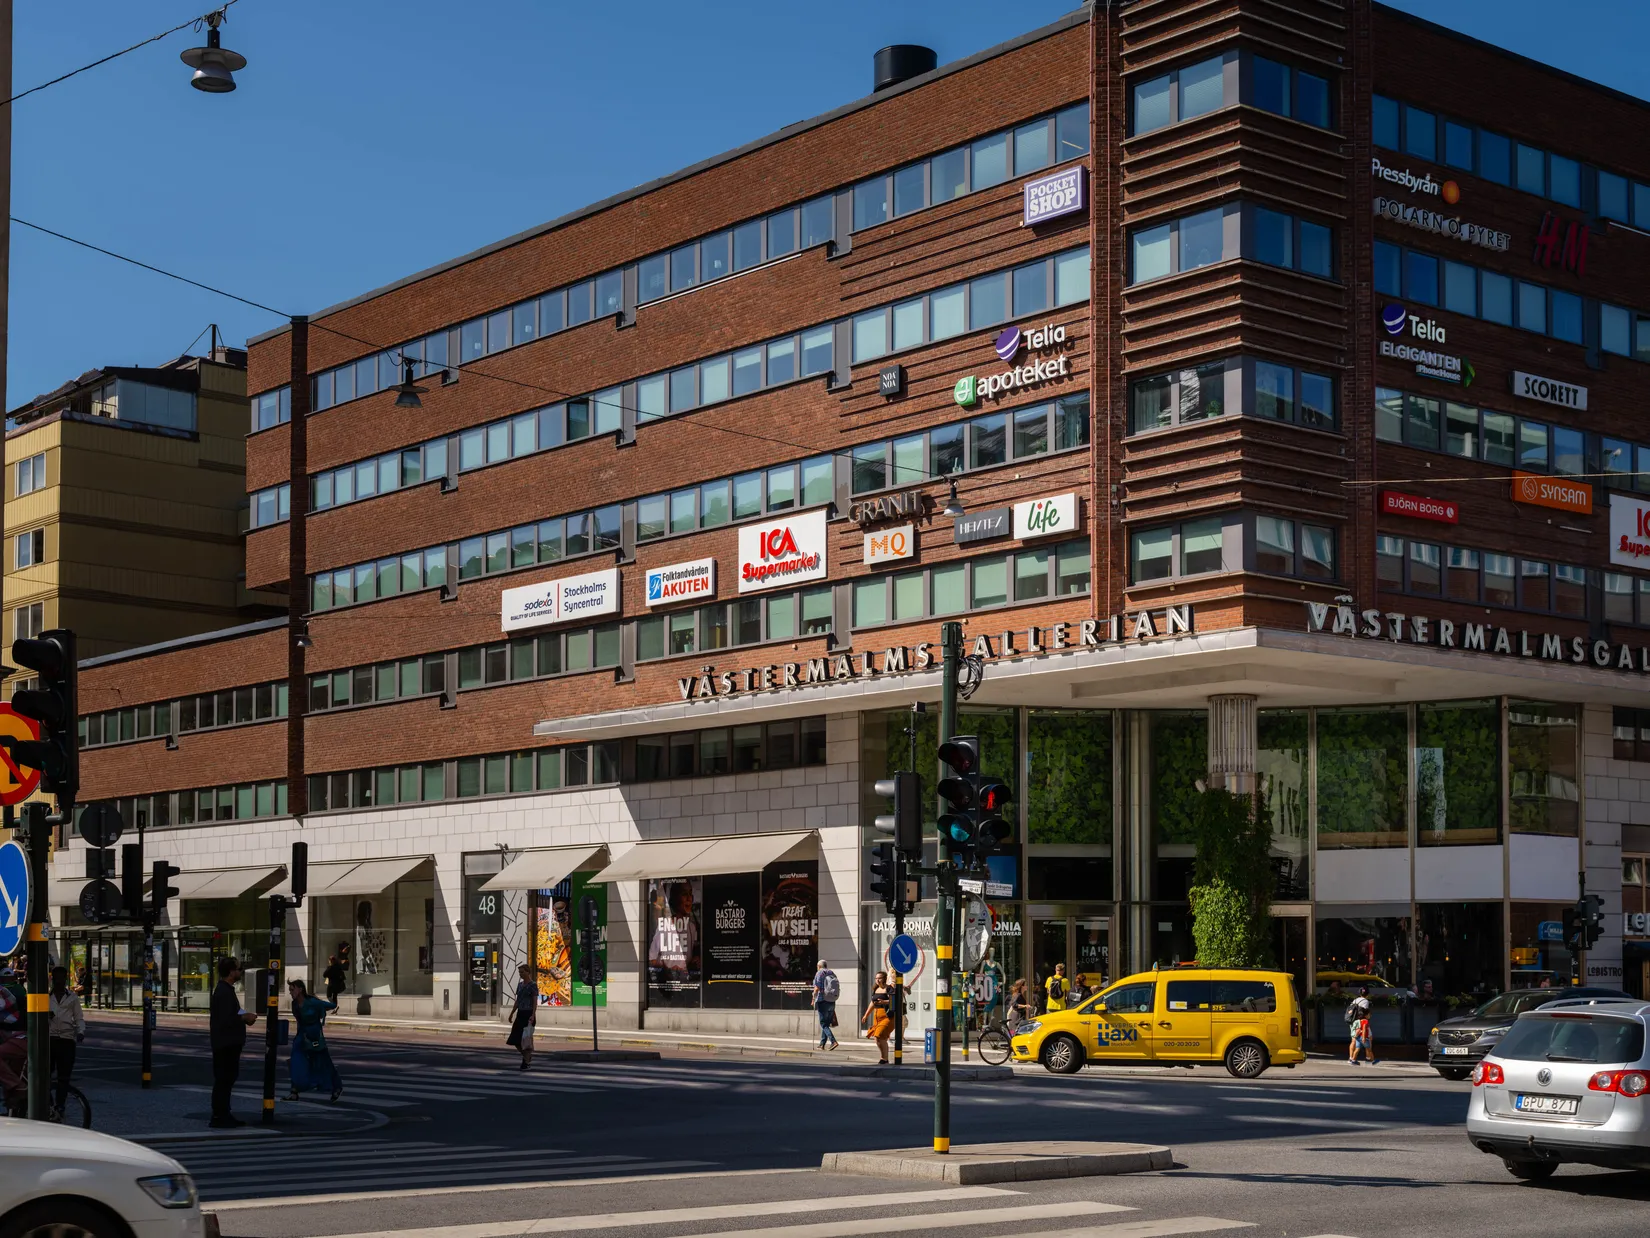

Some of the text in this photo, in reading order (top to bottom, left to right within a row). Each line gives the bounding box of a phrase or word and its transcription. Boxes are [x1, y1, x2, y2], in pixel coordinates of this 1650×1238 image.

[1030, 174, 1076, 200] POCKET
[1372, 157, 1438, 196] Pressbyrån
[1029, 187, 1077, 217] SHOP
[1375, 196, 1444, 233] POLARN
[1468, 224, 1512, 252] PYRET
[1023, 323, 1066, 350] Telia
[1408, 314, 1446, 344] Telia
[1379, 340, 1462, 372] ELGIGANTEN
[882, 371, 896, 381] NOA
[882, 380, 896, 390] NOA
[976, 354, 1068, 398] apoteket
[1524, 376, 1579, 406] SCORETT
[1540, 483, 1587, 506] SYNSAM
[848, 490, 924, 523] GRANIT
[1027, 500, 1060, 532] life
[1388, 496, 1444, 516] BJÖRN BORG
[760, 526, 800, 560] ICA
[870, 532, 907, 557] MQ
[662, 565, 709, 582] Folktandvården
[741, 553, 818, 580] Supermarket
[564, 583, 606, 597] Stockholms
[662, 576, 709, 598] AKUTEN
[524, 597, 553, 611] sodexo
[564, 596, 603, 611] Syncentral
[678, 603, 1194, 700] VÄSTERMALMSALLERIAN
[478, 895, 496, 915] 48
[715, 908, 746, 919] BASTARD
[781, 905, 806, 918] TREAT
[657, 916, 690, 933] ENJOY
[715, 918, 746, 929] BURGERS
[790, 919, 818, 936] SELF
[872, 921, 932, 932] CALZDONIA
[659, 933, 688, 953] LIFE
[1523, 1096, 1574, 1111] GPU 871
